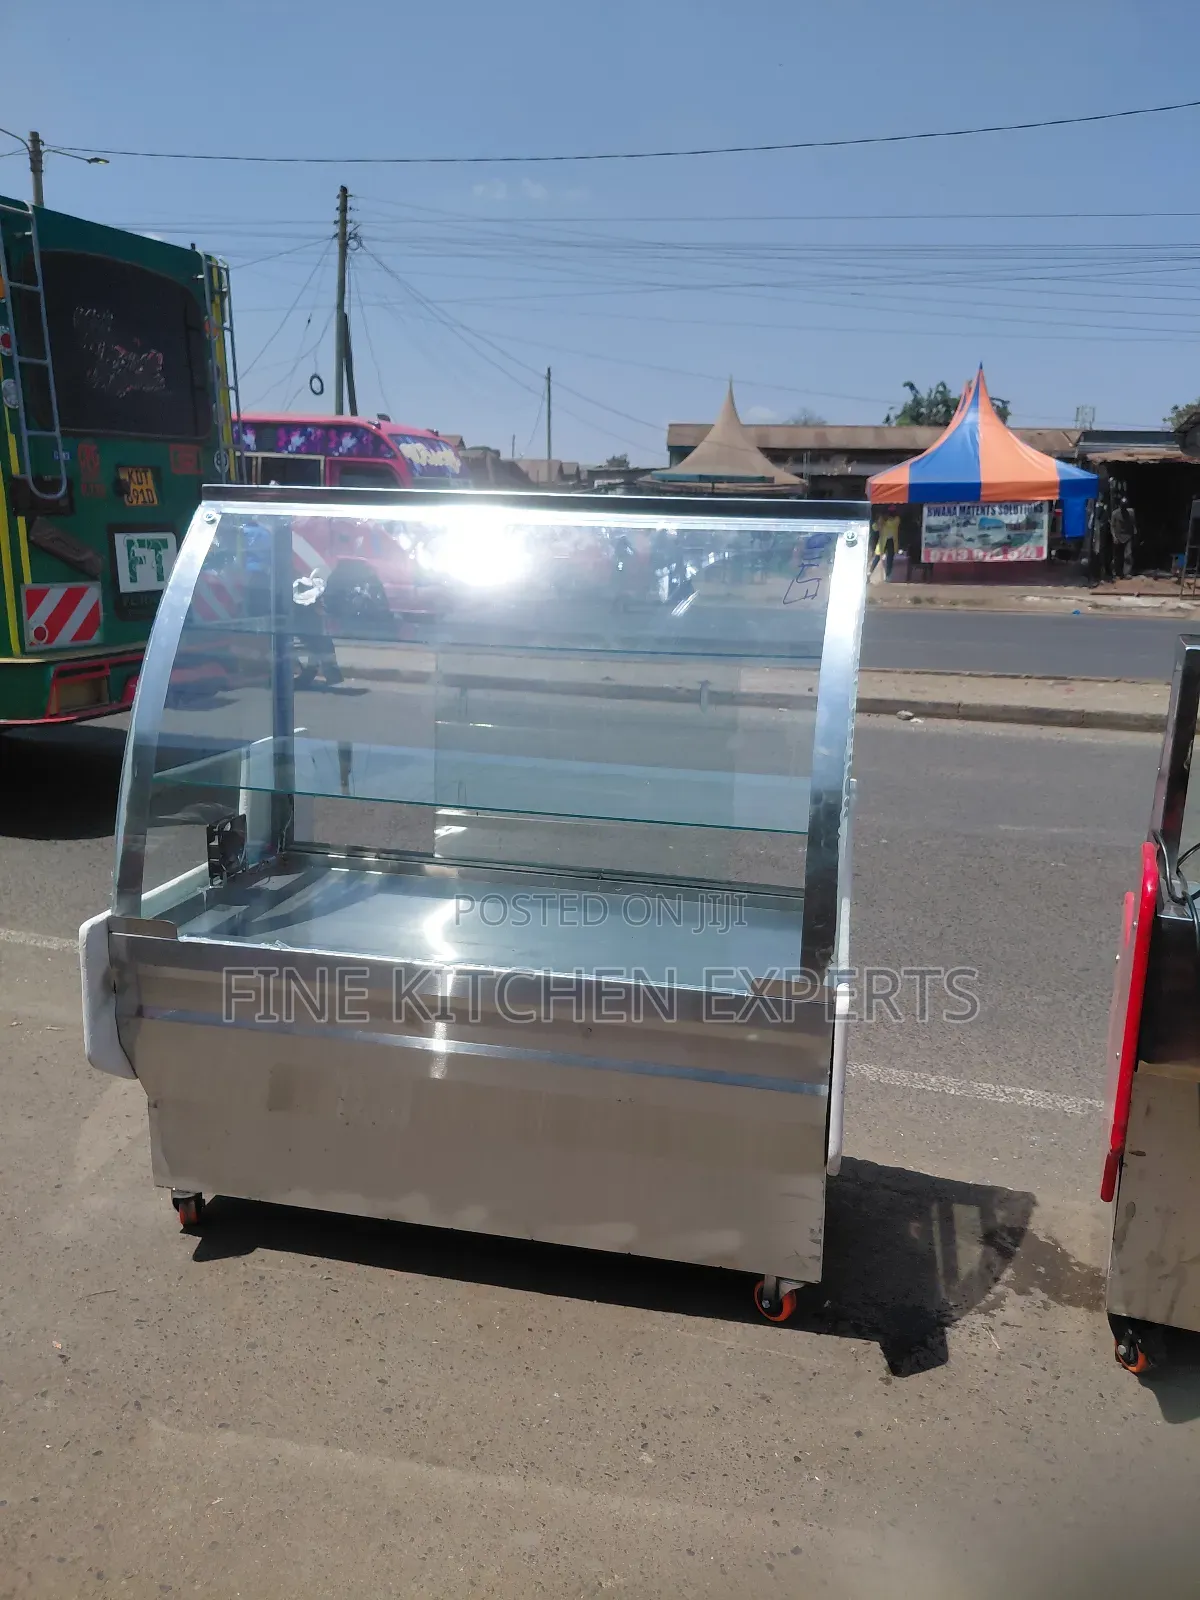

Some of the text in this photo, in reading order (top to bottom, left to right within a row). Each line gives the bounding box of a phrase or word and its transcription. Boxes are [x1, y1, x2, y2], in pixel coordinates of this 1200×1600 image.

[128, 468, 149, 486] KDT
[928, 505, 957, 517] BWANA
[126, 538, 168, 583] FT
